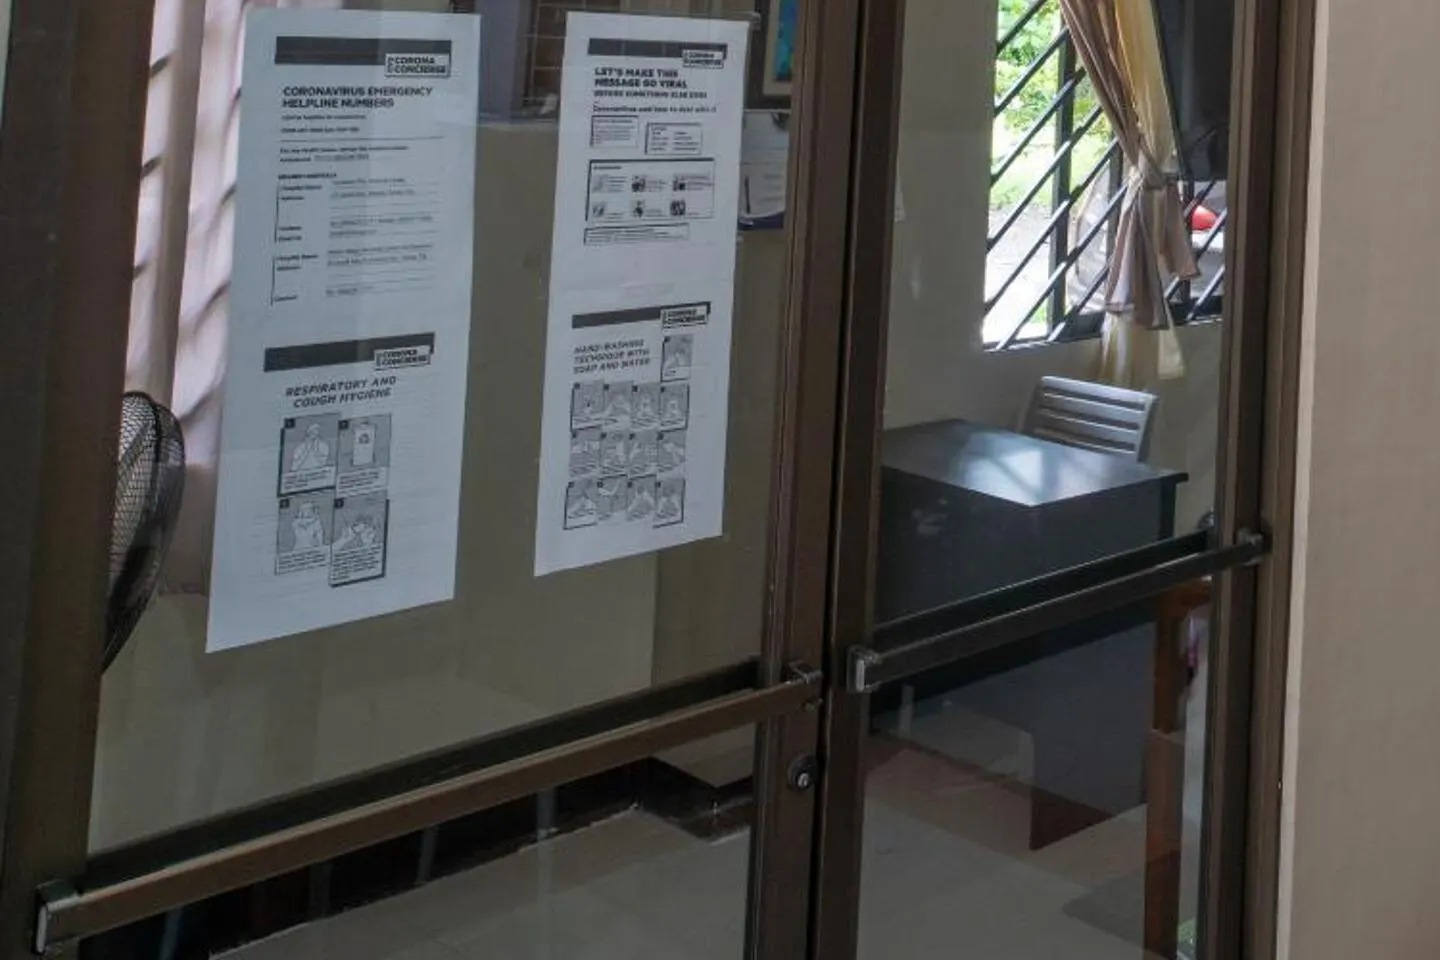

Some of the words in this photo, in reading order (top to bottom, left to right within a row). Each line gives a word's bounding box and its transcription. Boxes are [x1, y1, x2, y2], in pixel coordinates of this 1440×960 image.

[625, 68, 654, 78] MAKE
[594, 77, 641, 87] MESSAGE
[659, 79, 688, 89] VIRAL
[282, 86, 366, 97] CORONAVIRUS
[367, 86, 433, 97] EMERGENCY
[282, 98, 339, 109] HELPLINE
[341, 98, 395, 108] NUMBERS
[286, 378, 368, 397] RESPIRATORY
[371, 376, 397, 386] AND
[293, 394, 337, 408] COUGH
[339, 387, 393, 404] HYGIENE
